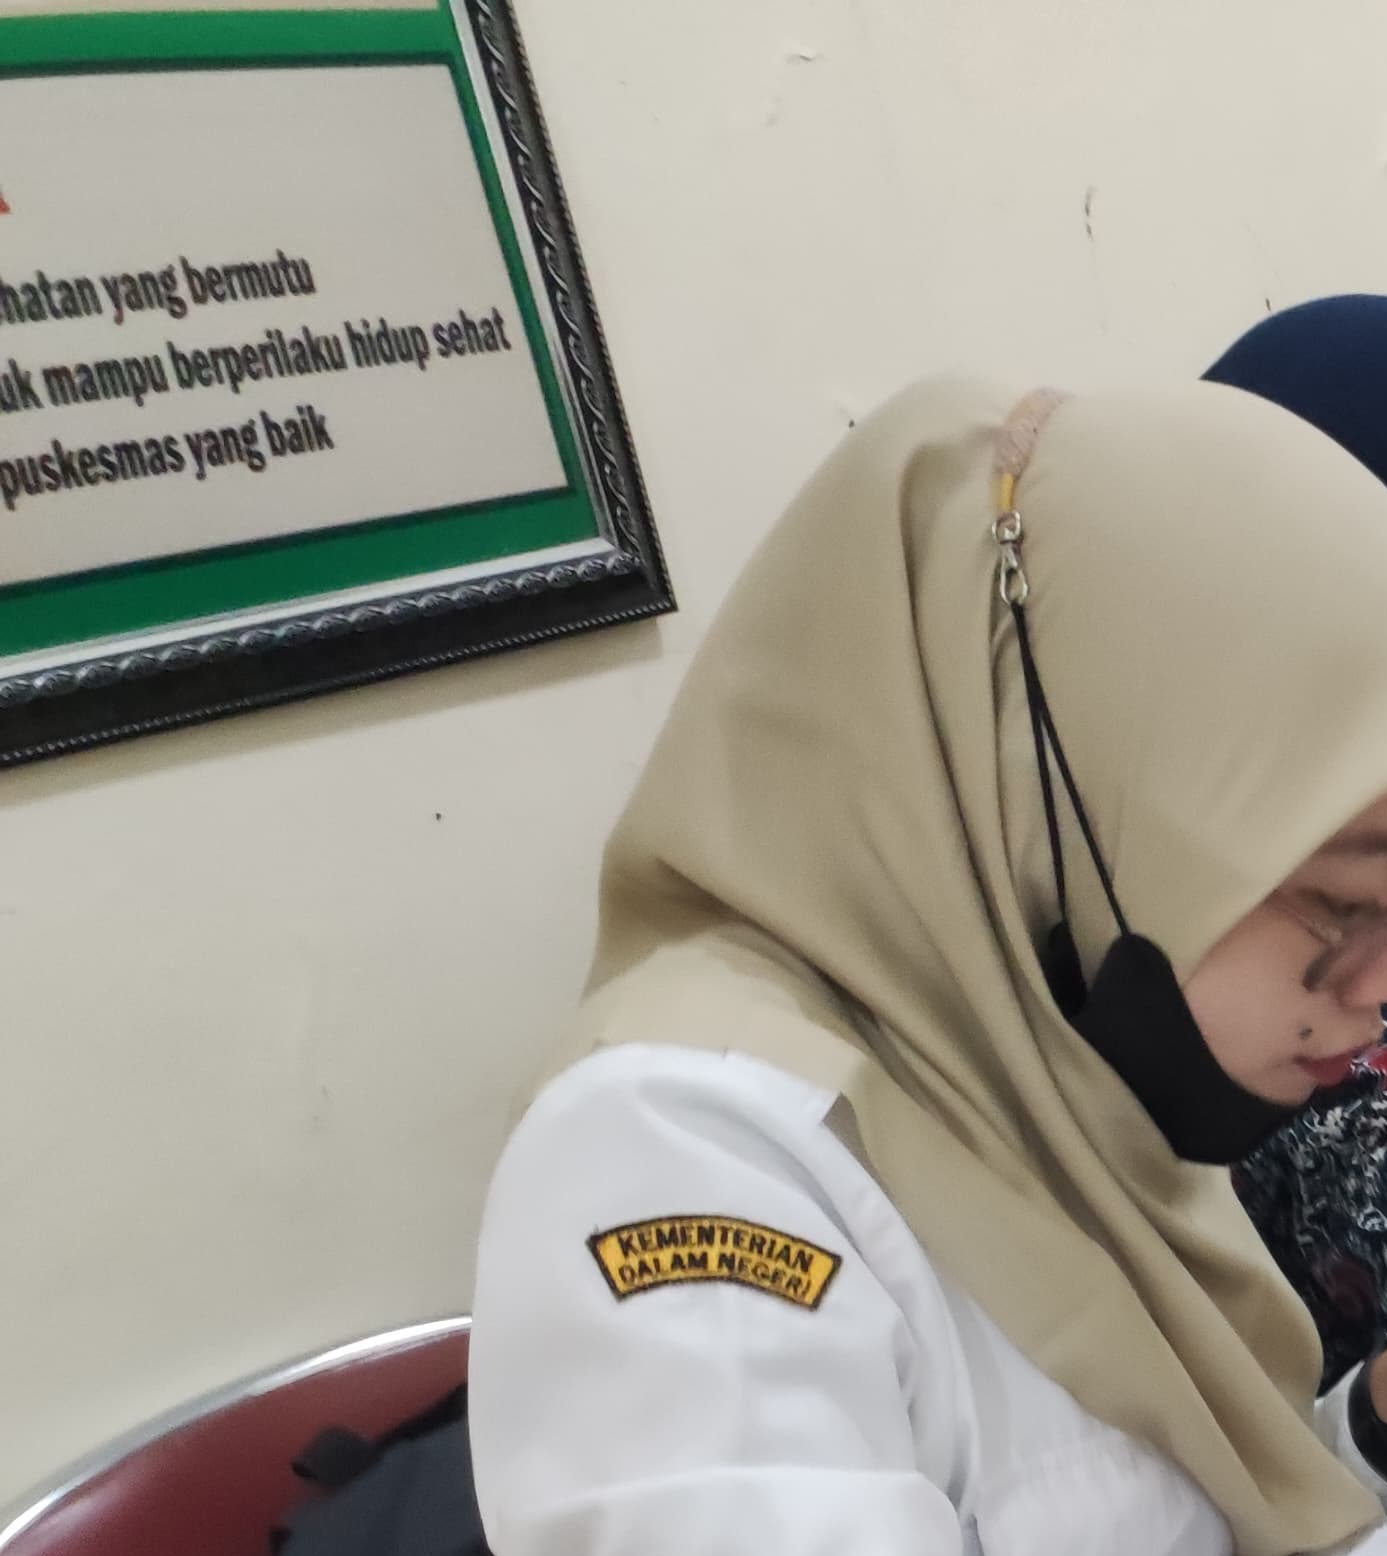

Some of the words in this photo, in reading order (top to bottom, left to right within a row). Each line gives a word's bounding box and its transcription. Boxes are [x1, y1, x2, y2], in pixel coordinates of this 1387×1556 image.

[100, 264, 188, 325] yang
[179, 248, 316, 305] bermutu
[42, 354, 170, 407] mampu
[166, 325, 347, 394] berperilaku
[343, 316, 430, 371] hidup
[432, 306, 512, 358] sehat
[0, 438, 186, 511] puskesmas
[184, 419, 267, 481] yang
[259, 404, 335, 457] baik
[617, 1224, 813, 1273] KEMENTERIAN
[618, 1251, 708, 1284] DALAM
[717, 1253, 812, 1299] NEGERI
